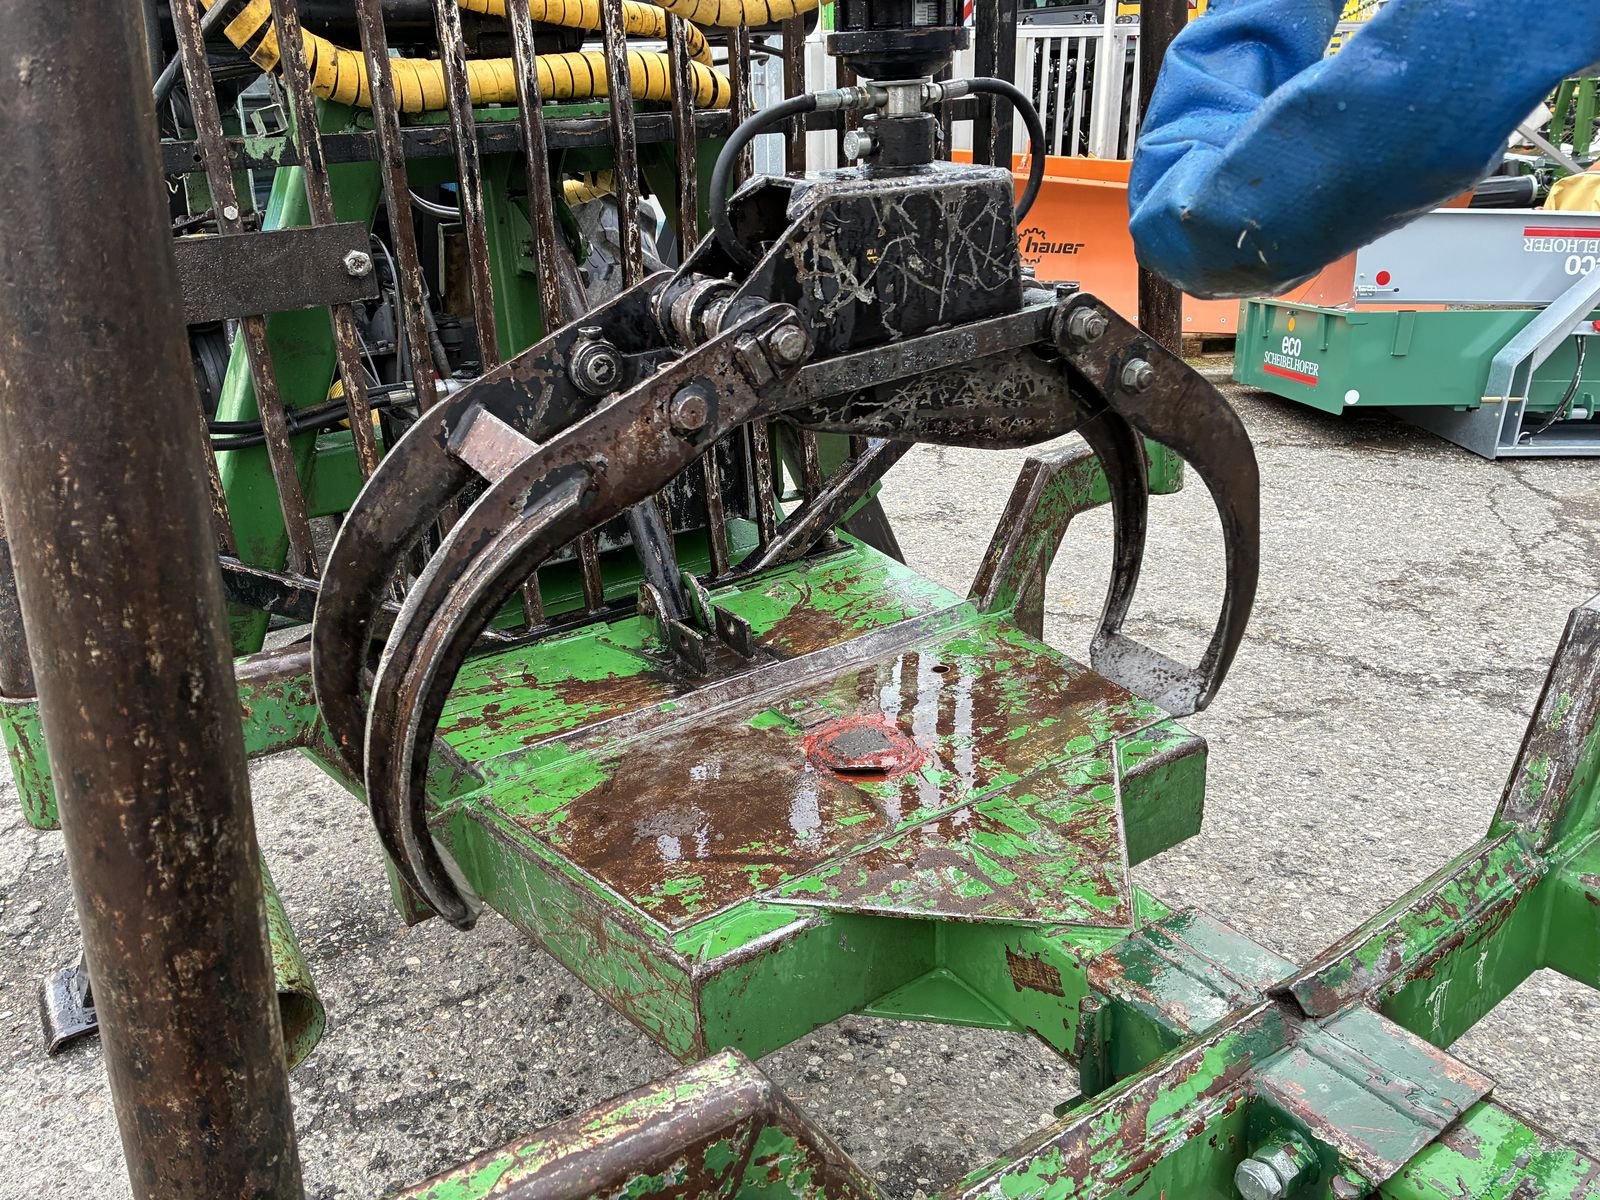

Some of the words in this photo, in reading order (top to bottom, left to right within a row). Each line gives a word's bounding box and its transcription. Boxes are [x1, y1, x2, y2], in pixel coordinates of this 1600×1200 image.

[1025, 236, 1085, 254] hauer
[1564, 254, 1600, 276] co
[1281, 336, 1302, 357] eco
[1263, 350, 1319, 377] SCHEIBELHOFER
